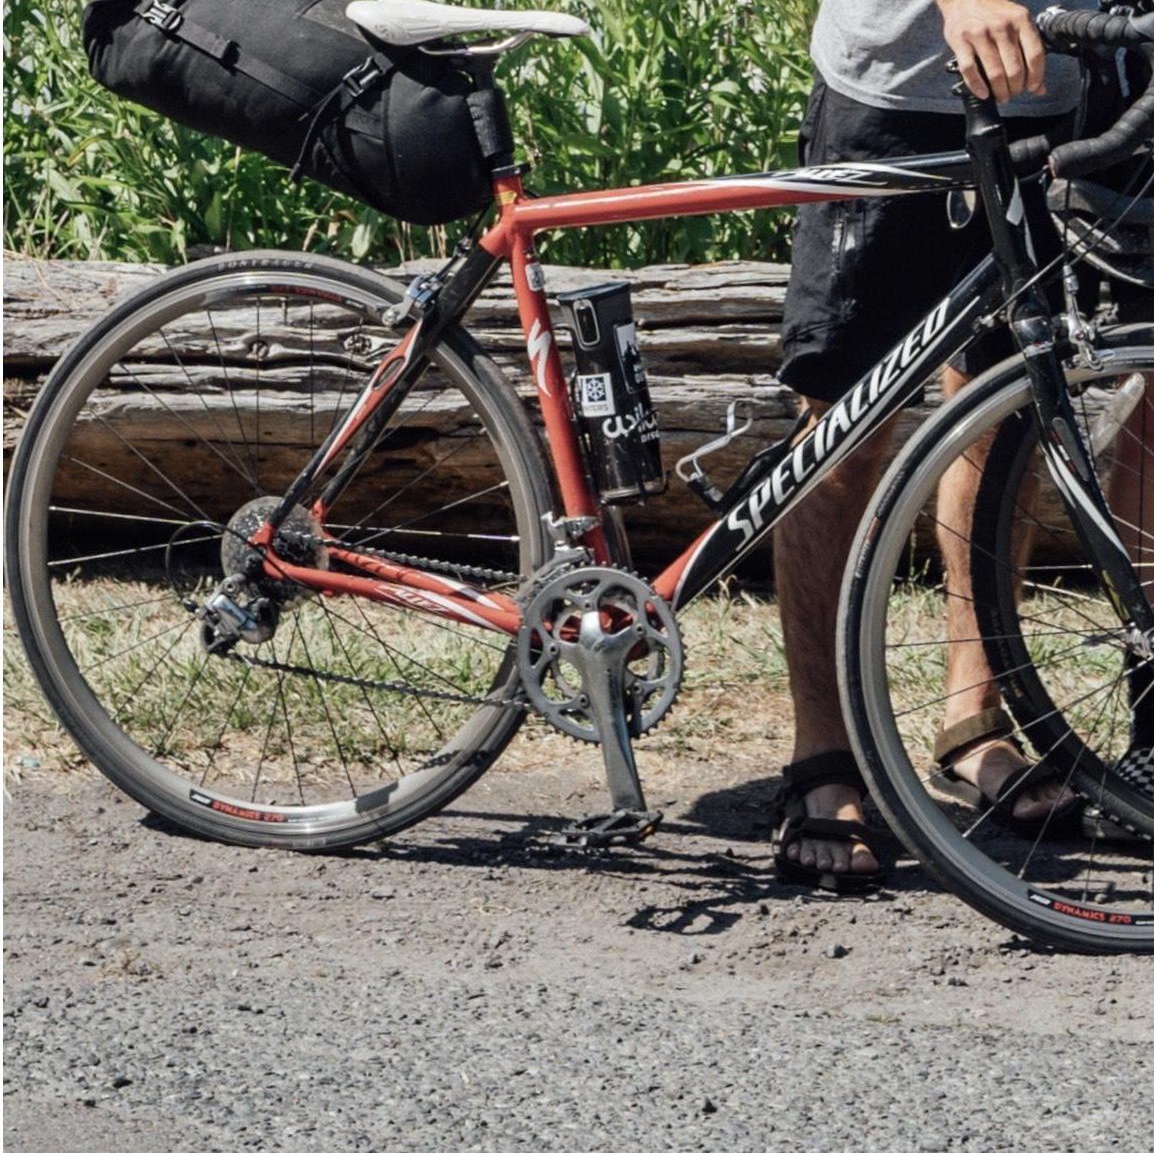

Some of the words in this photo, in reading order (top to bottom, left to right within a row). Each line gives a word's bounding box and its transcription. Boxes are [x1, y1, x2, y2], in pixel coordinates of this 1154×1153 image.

[727, 297, 950, 552] SPECIALIZED
[211, 801, 260, 821] DYNAMICS
[263, 812, 285, 823] 270
[1053, 902, 1106, 922] DYNAMICS
[1109, 914, 1132, 925] 270
